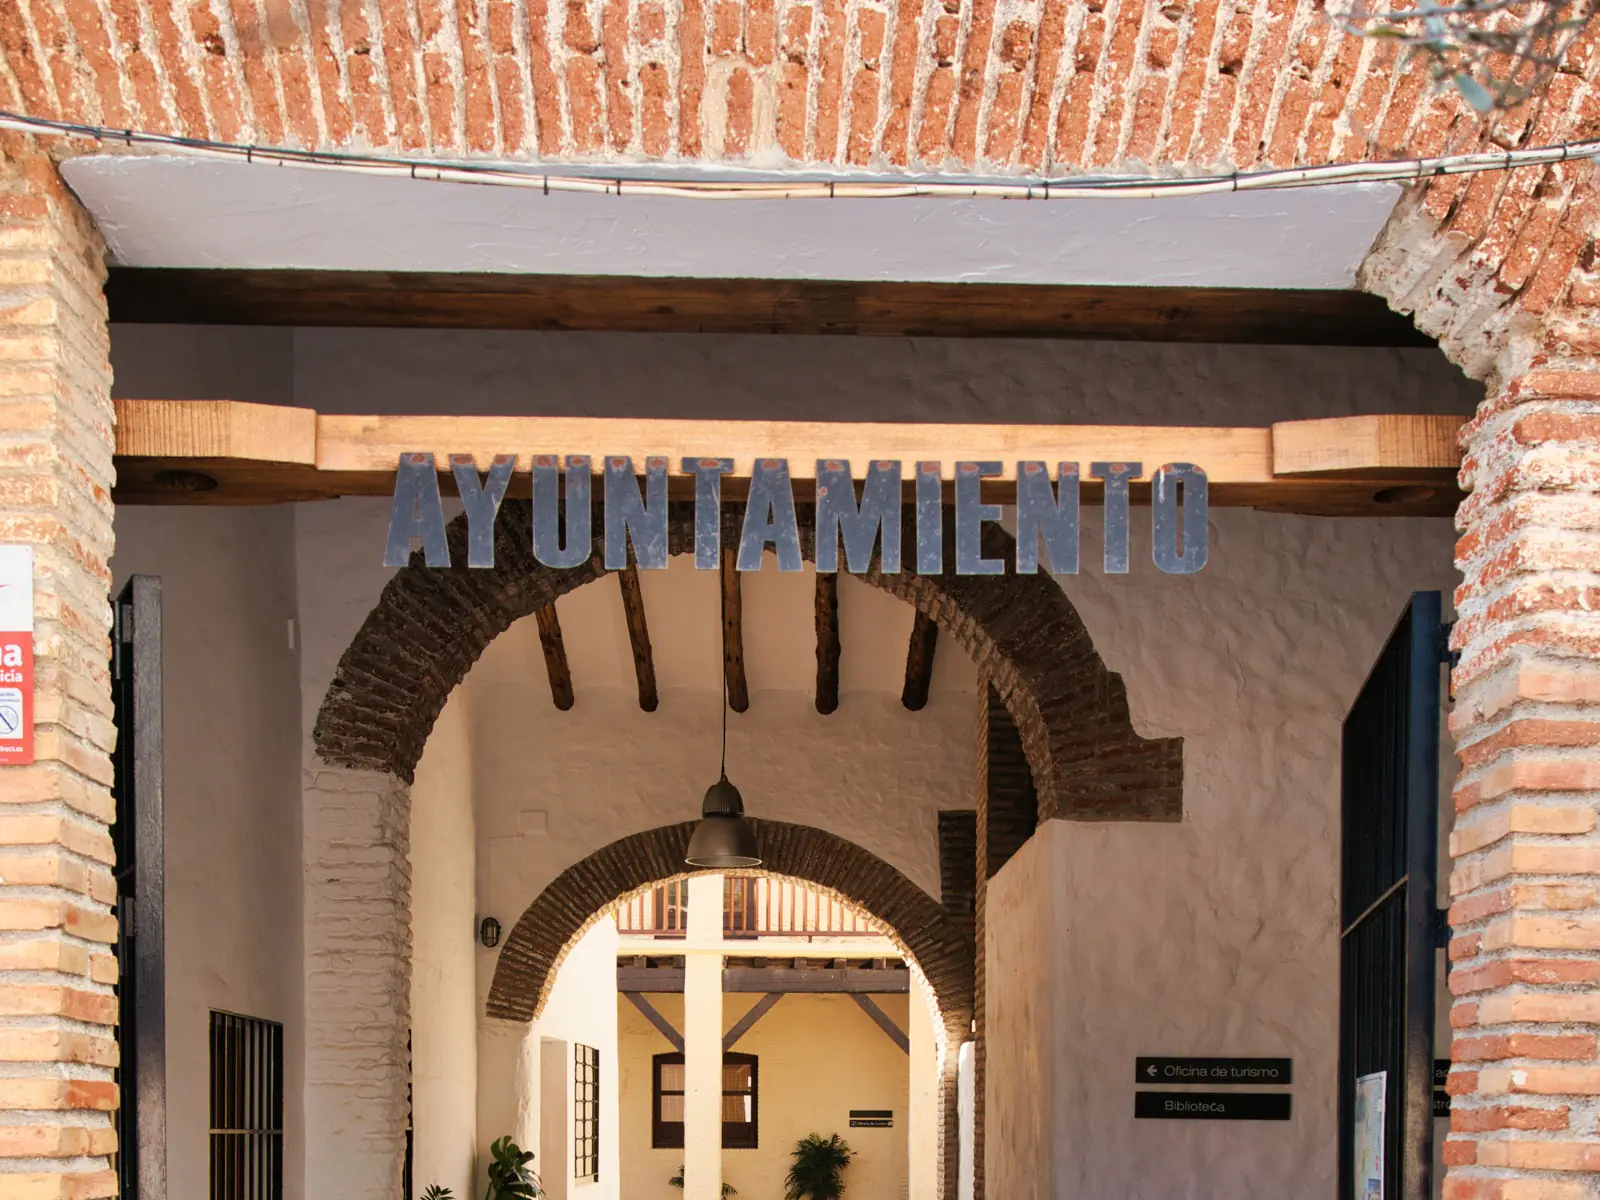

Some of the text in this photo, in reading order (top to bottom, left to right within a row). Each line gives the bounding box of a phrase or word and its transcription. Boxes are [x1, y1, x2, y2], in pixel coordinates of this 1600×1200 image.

[383, 452, 1209, 575] AYUNTAMIENTO
[1164, 1065, 1279, 1078] Oficina de turismo
[1164, 1100, 1226, 1112] Biblioteca
